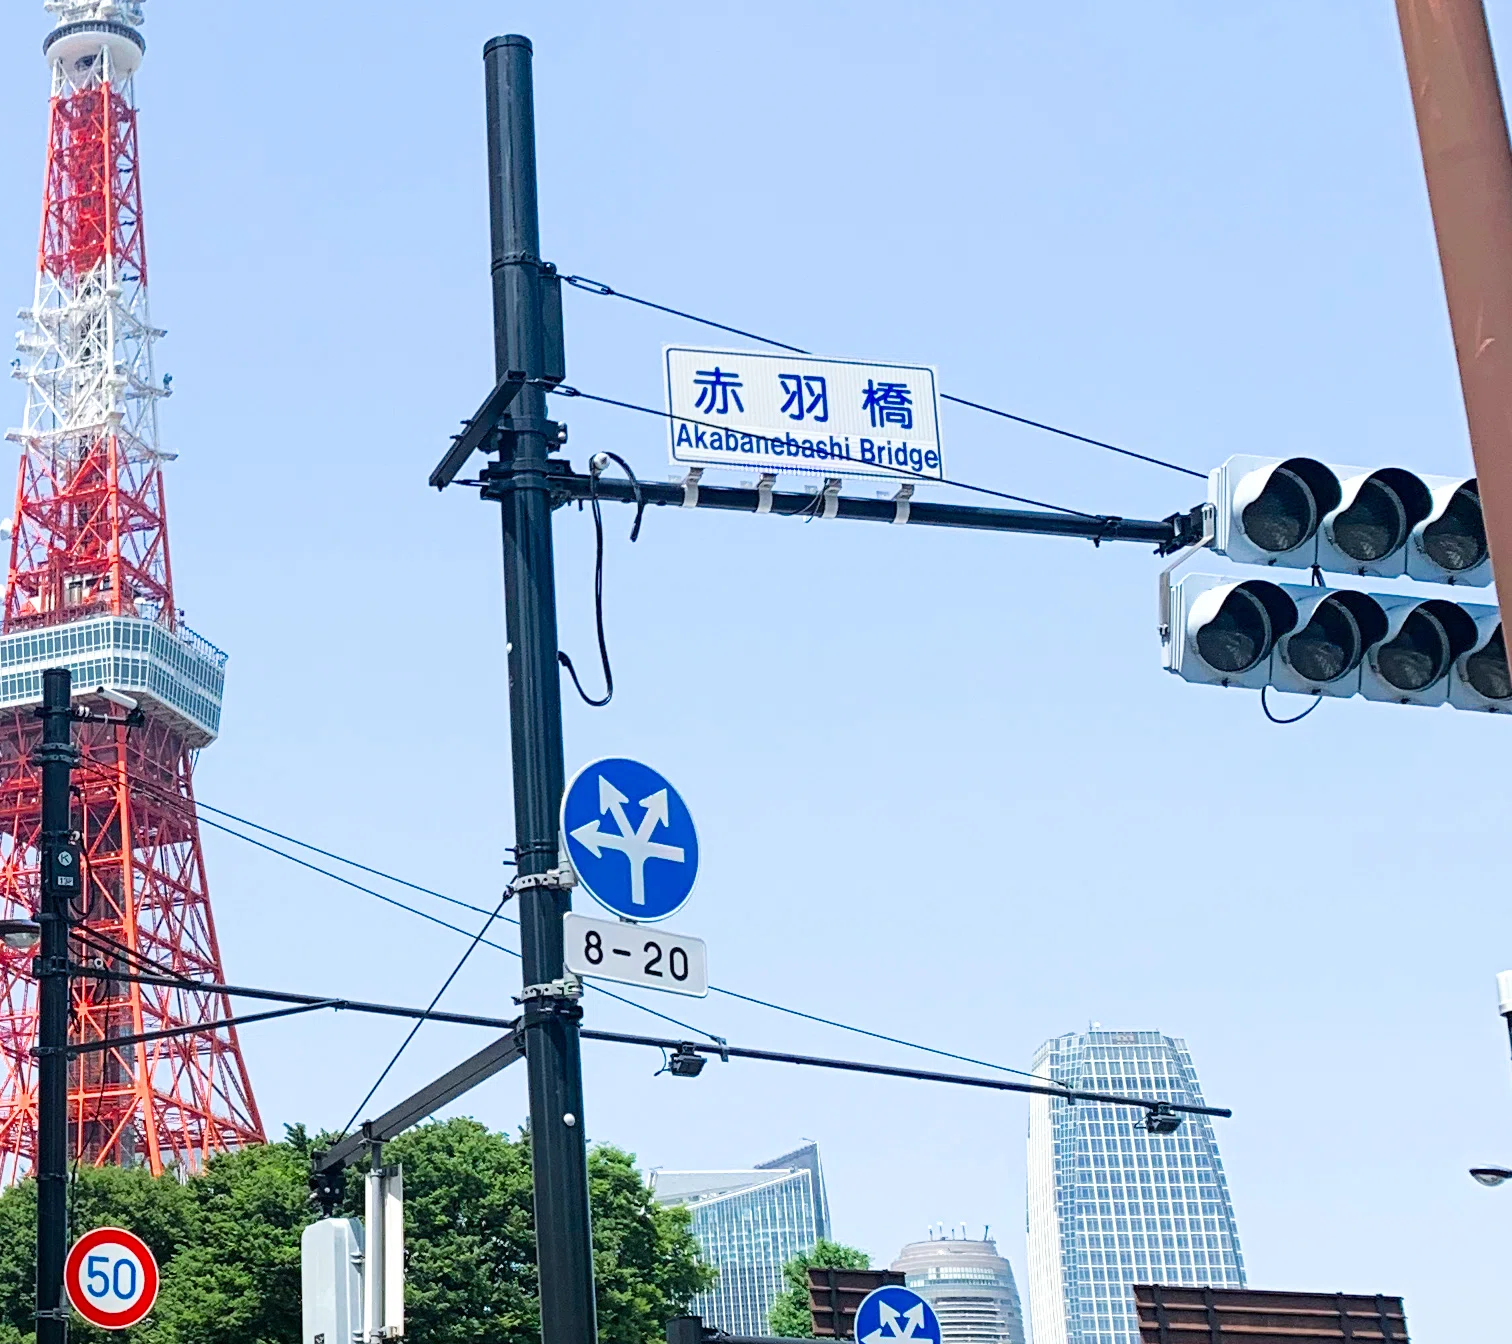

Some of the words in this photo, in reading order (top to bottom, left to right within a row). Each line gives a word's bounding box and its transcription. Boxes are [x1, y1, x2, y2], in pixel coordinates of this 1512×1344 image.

[693, 366, 913, 430] 赤羽橋
[676, 423, 850, 461] Akabanebashi
[860, 438, 939, 472] Bridge
[87, 1255, 137, 1300] 50
